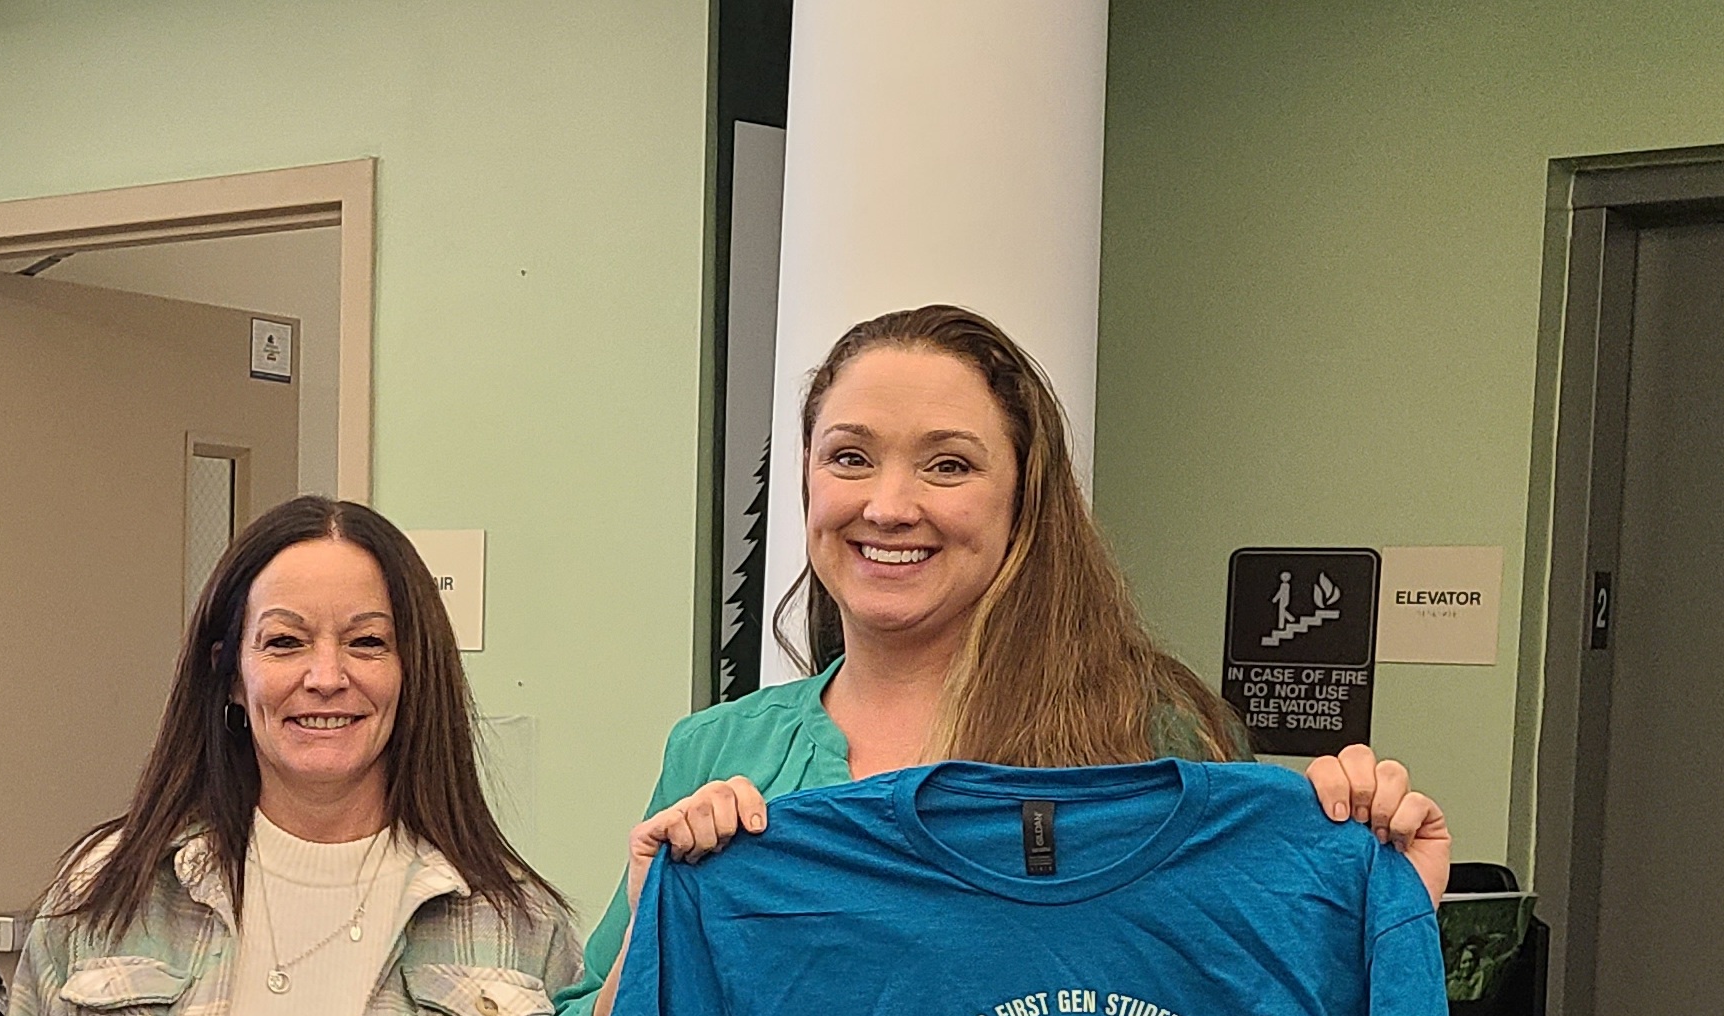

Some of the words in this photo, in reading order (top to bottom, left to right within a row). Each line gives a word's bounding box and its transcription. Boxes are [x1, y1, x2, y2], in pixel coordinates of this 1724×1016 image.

[1395, 590, 1482, 606] ELEVATOR
[1596, 587, 1607, 629] 2
[1227, 666, 1244, 681] IN
[1250, 667, 1295, 683] CASE
[1301, 669, 1325, 684] OF
[1331, 670, 1368, 685] FIRE
[1243, 682, 1268, 697] DO
[1275, 684, 1309, 698] NOT
[1316, 685, 1349, 700] USE
[1249, 697, 1341, 715] ELEVATORS
[1245, 713, 1279, 728] USE
[1285, 714, 1343, 731] STAIRS
[1058, 989, 1096, 1013] GEN
